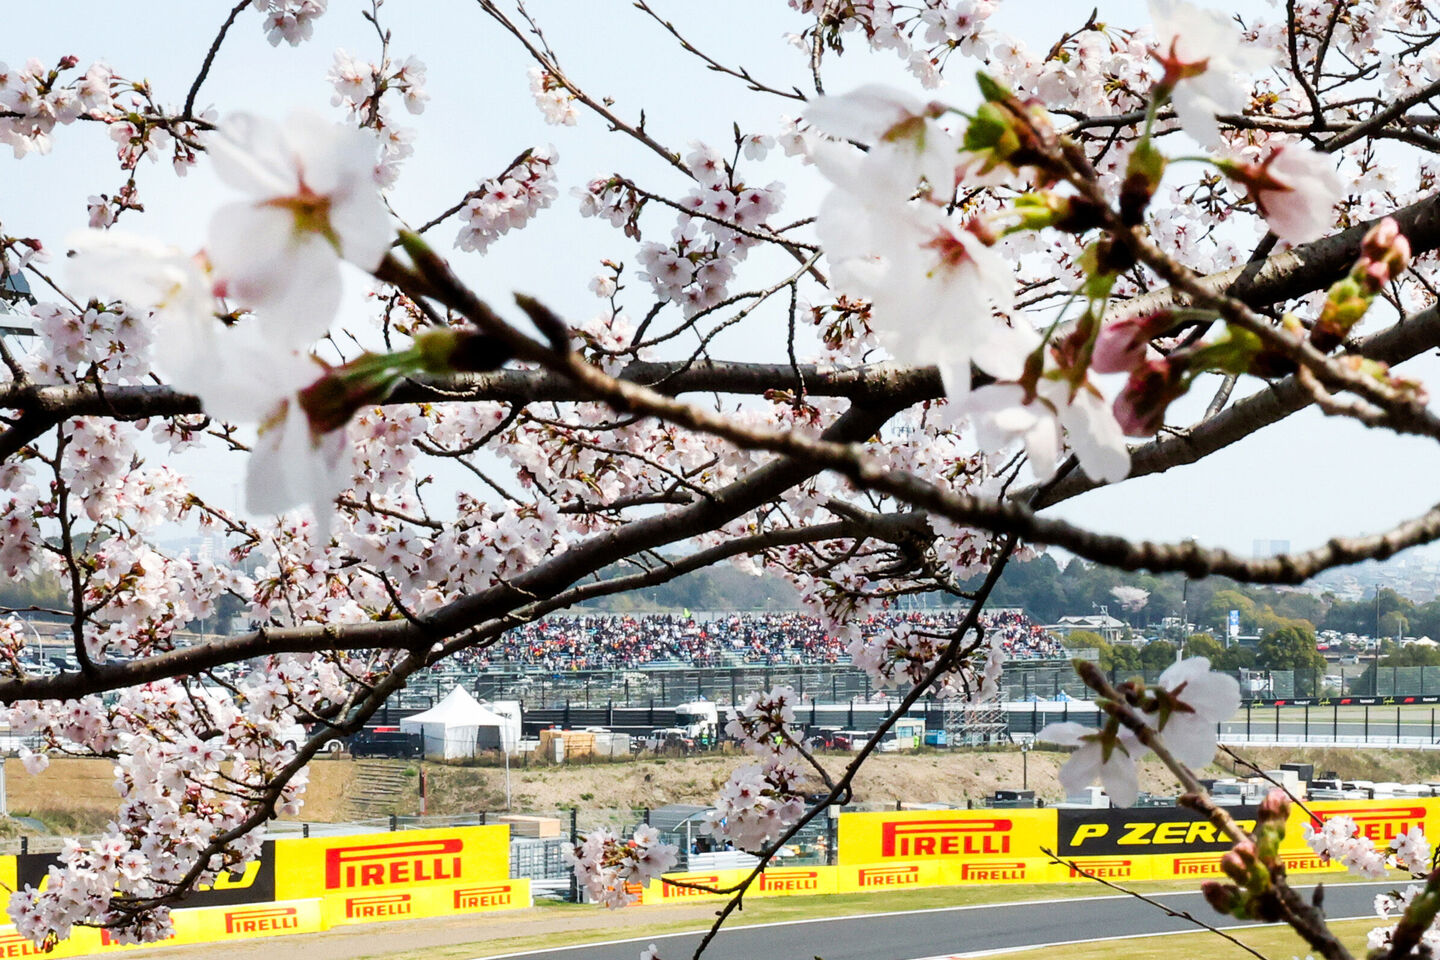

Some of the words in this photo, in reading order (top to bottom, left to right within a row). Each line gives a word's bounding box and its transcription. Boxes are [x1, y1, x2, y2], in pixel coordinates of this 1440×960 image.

[1069, 823, 1110, 847] P
[1310, 807, 1427, 840] PELLI
[882, 819, 1013, 857] PIRELLI
[325, 838, 464, 890] PIRELLI
[961, 863, 1026, 880] PIRELLI
[1173, 856, 1226, 875] PIREL
[1280, 852, 1331, 870] RELLI
[759, 871, 818, 891] PIRELLI
[858, 866, 919, 886] PIRELLI
[345, 893, 412, 919] PIRELLI
[453, 885, 512, 909] PIRELLI
[225, 907, 298, 934] PIRELLI
